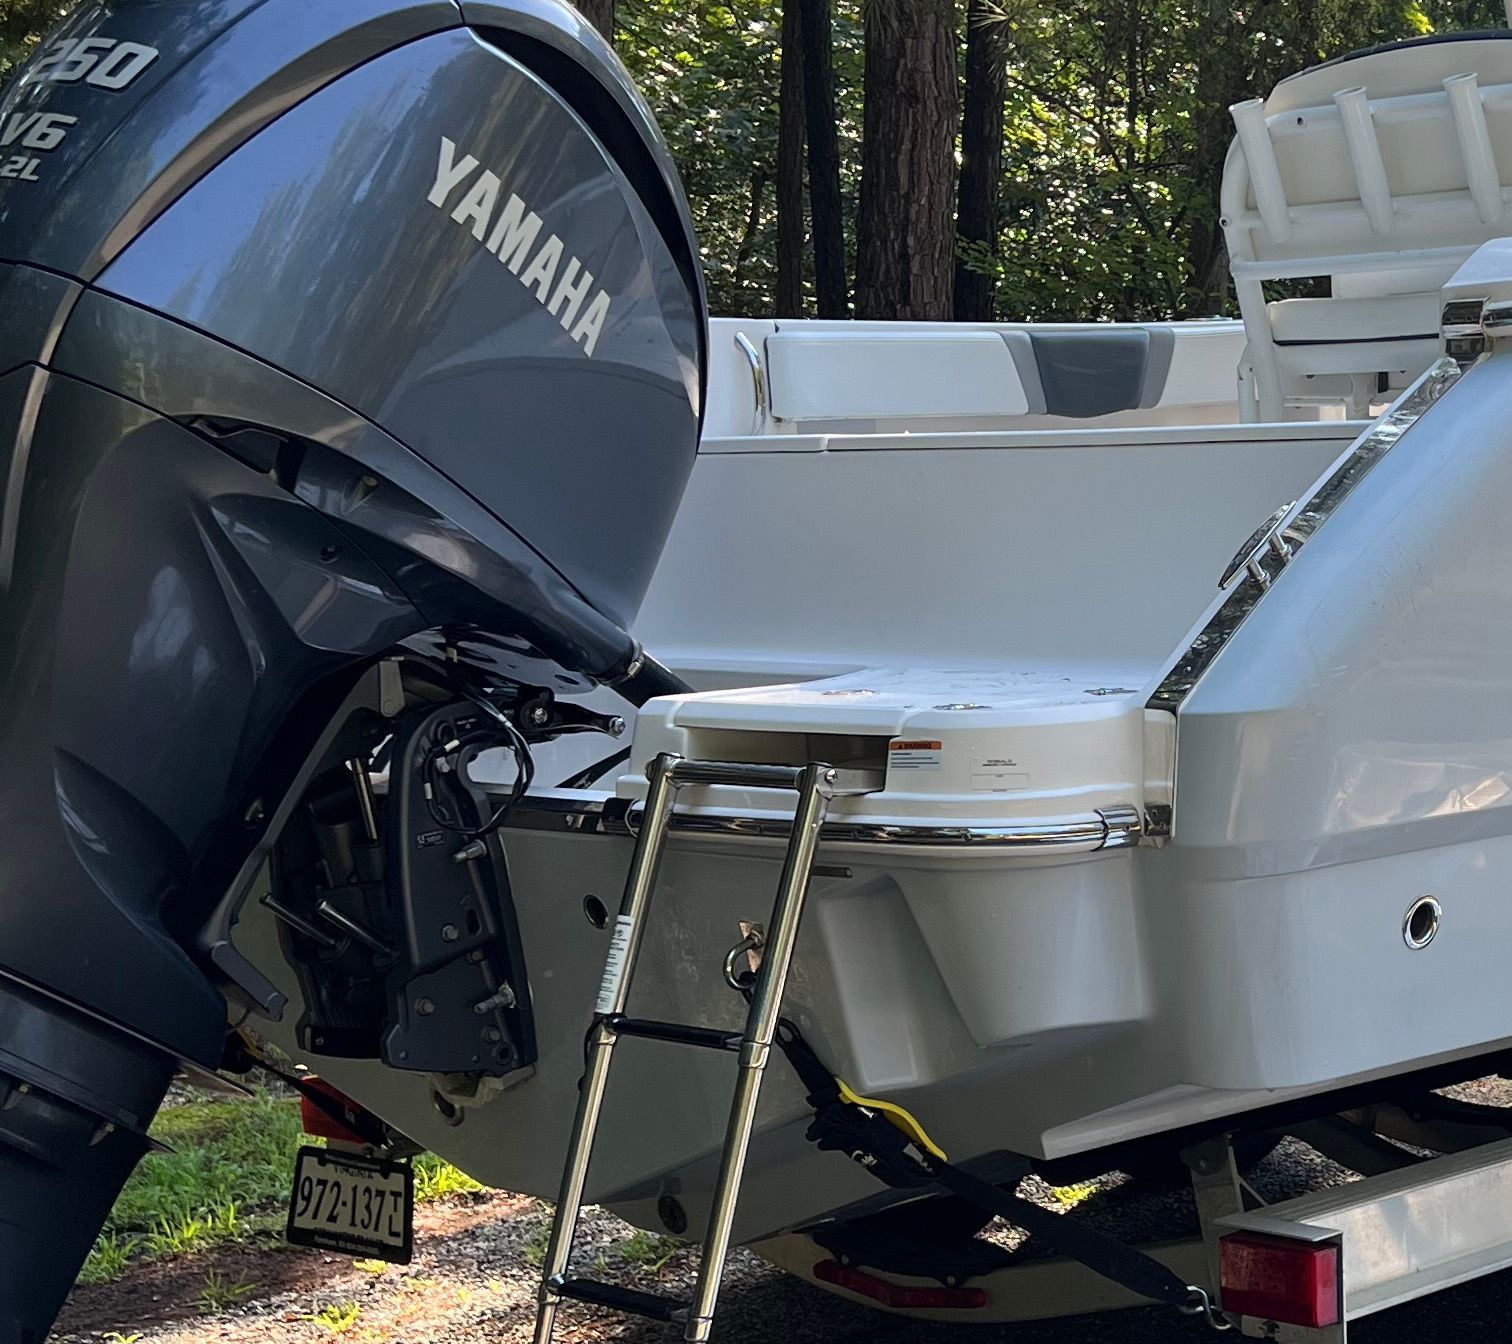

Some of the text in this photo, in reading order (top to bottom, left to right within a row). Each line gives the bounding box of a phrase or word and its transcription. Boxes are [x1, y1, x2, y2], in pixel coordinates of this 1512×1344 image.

[23, 37, 160, 92] 250
[0, 112, 78, 150] V6
[427, 135, 611, 358] YAMAHA
[297, 1175, 387, 1233] 972-137
